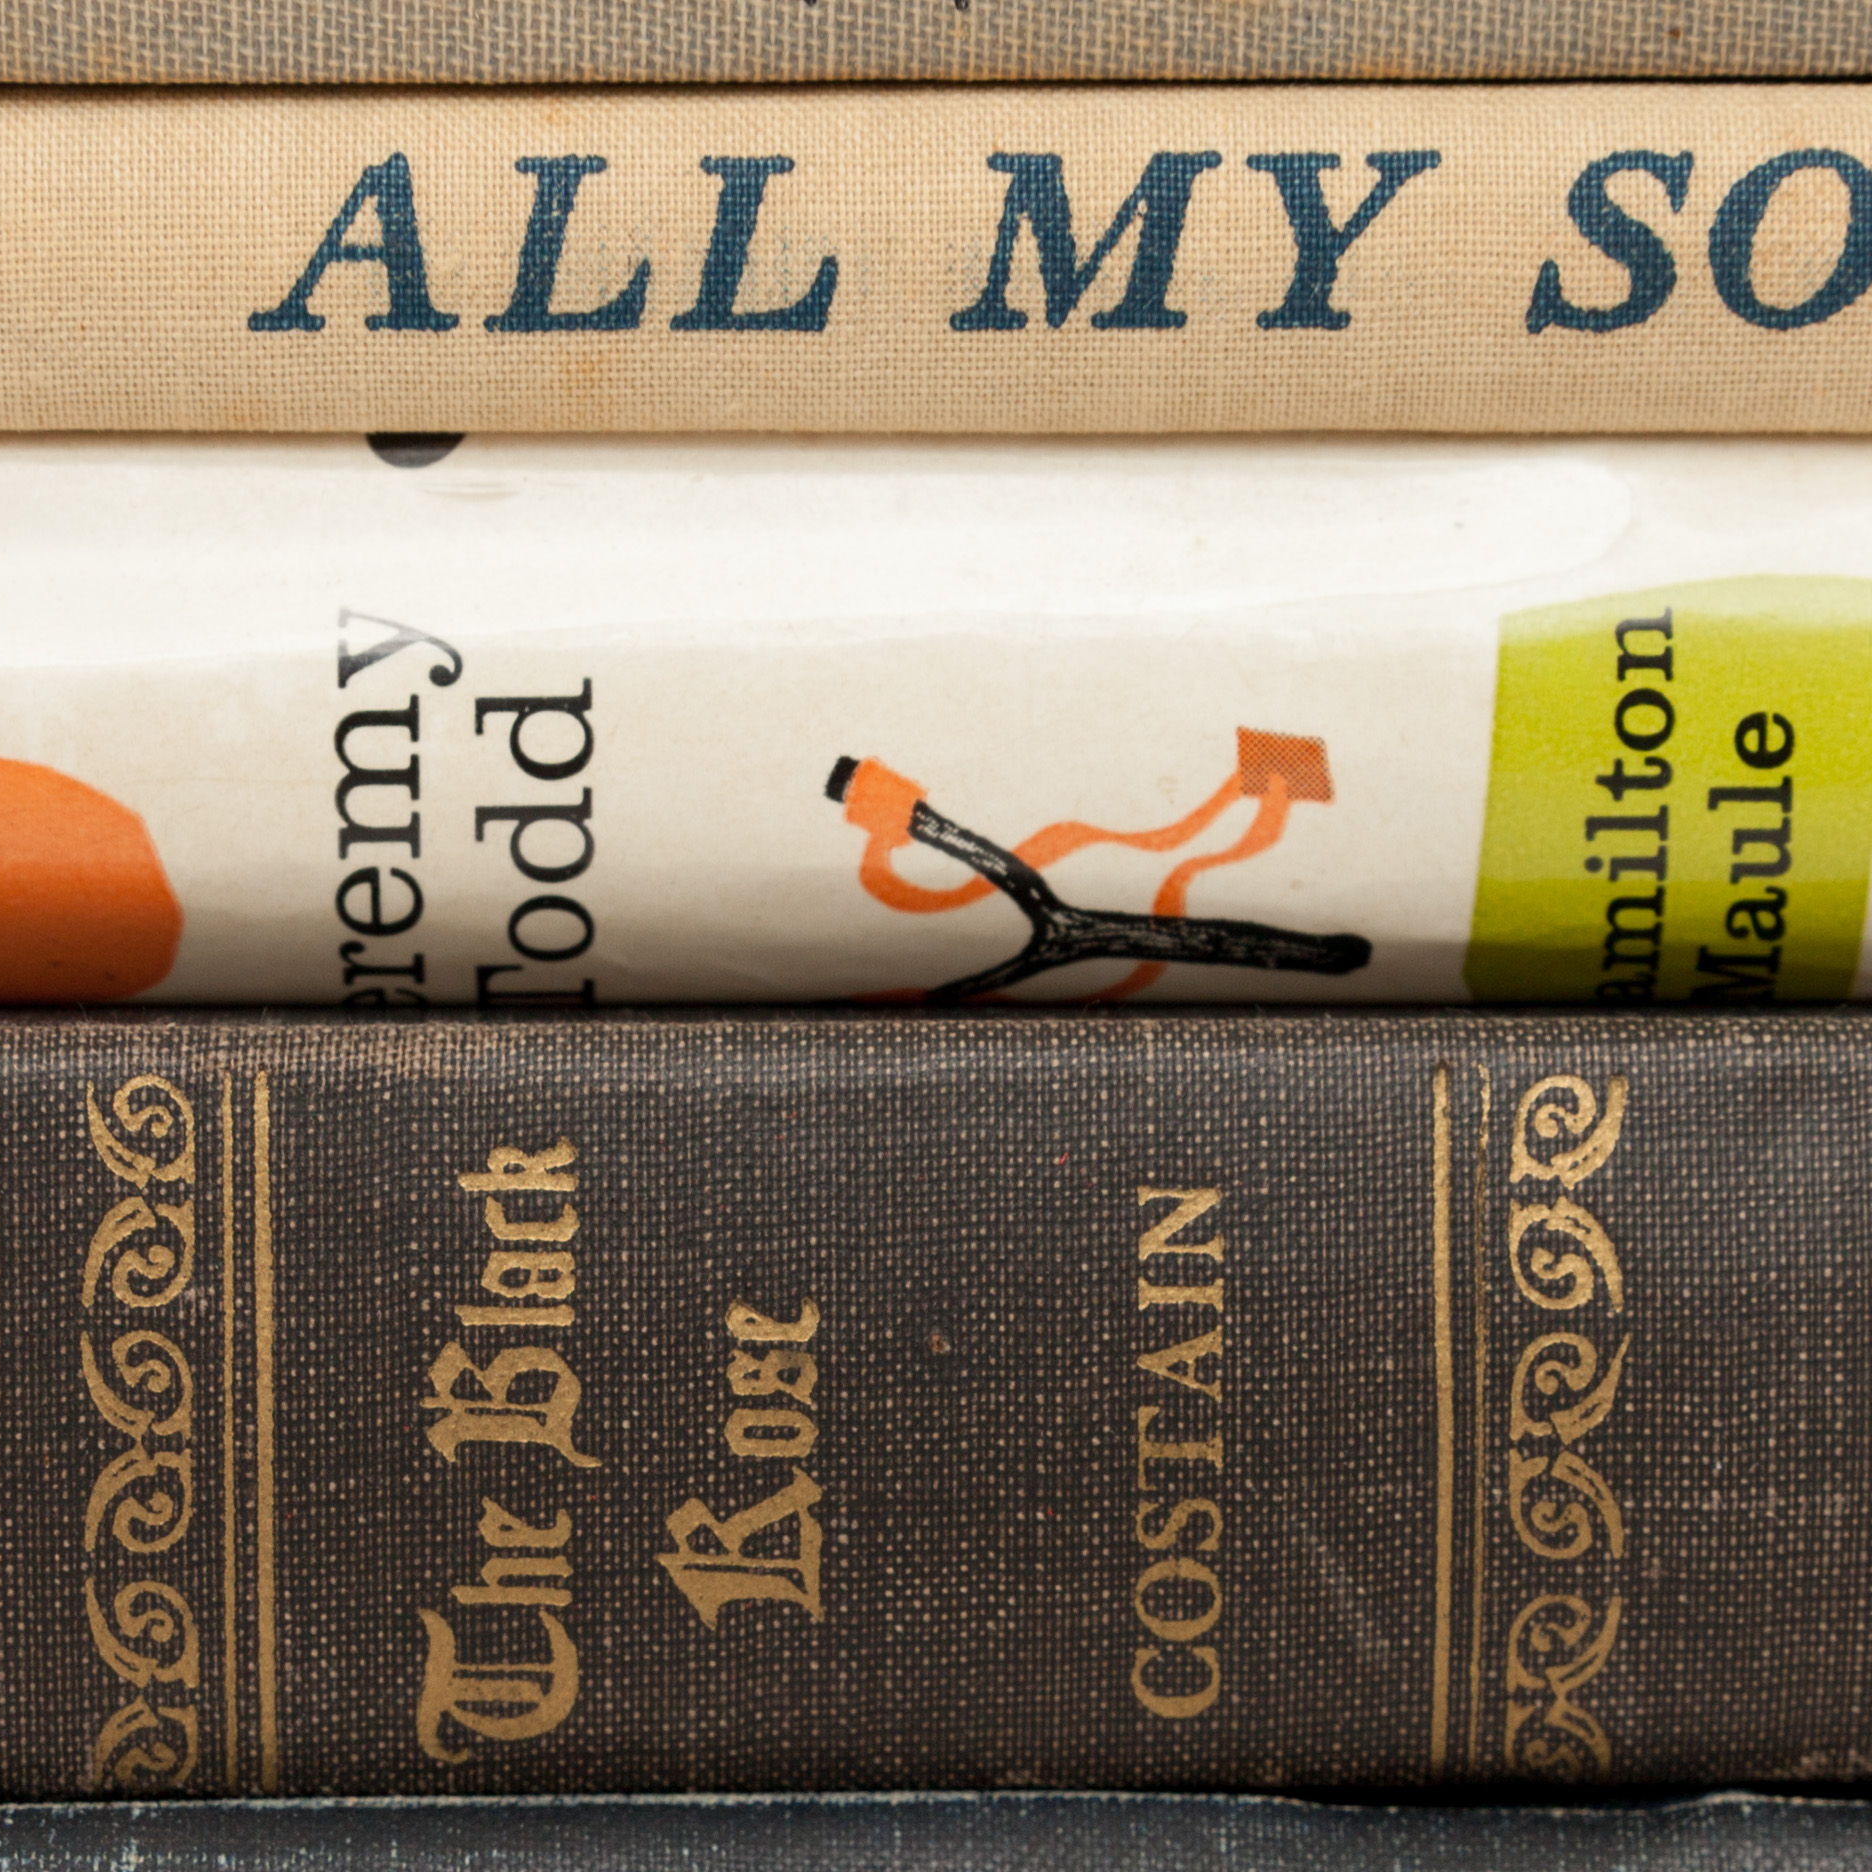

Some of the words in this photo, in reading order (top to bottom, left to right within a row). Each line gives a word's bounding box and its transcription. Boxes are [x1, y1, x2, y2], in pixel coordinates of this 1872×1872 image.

[249, 150, 841, 335] ALL
[950, 150, 1442, 335] MY
[474, 677, 596, 1010] Todd
[1584, 605, 1677, 1006] amilton
[1689, 710, 1796, 1006] Maule
[420, 1135, 603, 1468] Black
[658, 1297, 824, 1631] Rose
[1130, 1186, 1225, 1719] COSTAIN
[416, 1498, 580, 1765] The
